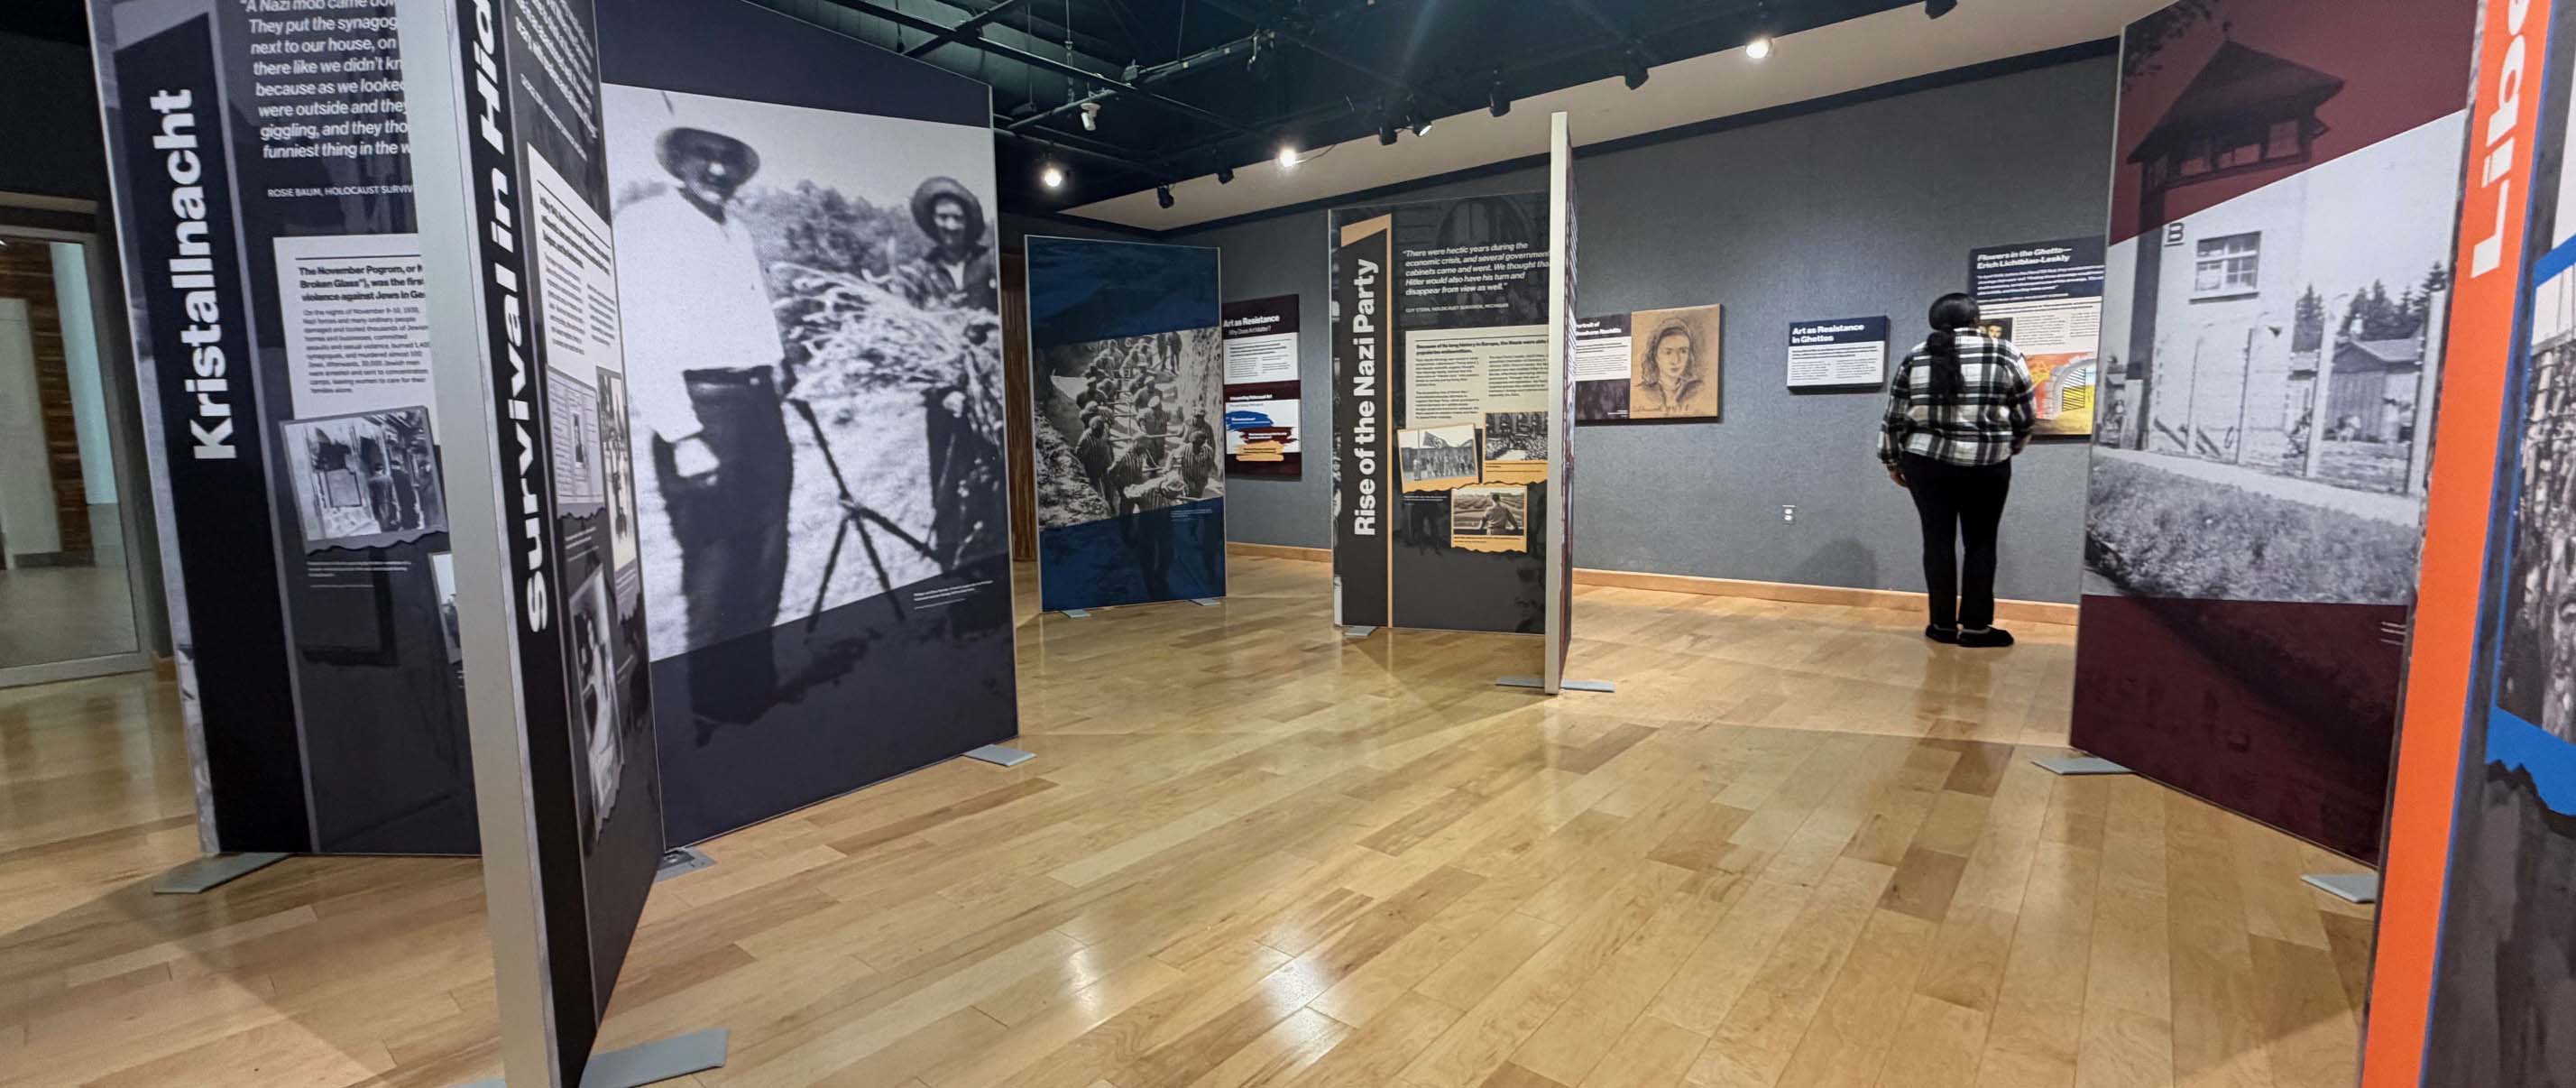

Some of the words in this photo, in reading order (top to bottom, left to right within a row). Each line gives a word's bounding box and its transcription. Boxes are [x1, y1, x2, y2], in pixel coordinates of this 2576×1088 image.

[259, 0, 290, 12] Nazi
[293, 0, 325, 11] mob
[327, 0, 368, 8] came
[249, 17, 287, 35] They
[286, 18, 310, 34] put
[312, 16, 336, 31] the
[251, 41, 281, 54] next
[285, 41, 299, 53] to
[302, 41, 326, 52] our
[327, 37, 375, 52] house,
[377, 38, 396, 49] on
[253, 61, 291, 76] there
[293, 60, 317, 74] like
[320, 61, 341, 72] we
[255, 82, 316, 97] because
[317, 85, 335, 94] as
[337, 83, 358, 94] we
[258, 105, 294, 117] were
[296, 101, 348, 115] outside
[350, 100, 378, 113] and
[260, 124, 319, 141] giggling,
[322, 122, 349, 135] and
[352, 121, 382, 136] they
[262, 144, 319, 159] funniest
[322, 143, 357, 159] thing
[360, 143, 373, 155] in
[375, 141, 398, 154] the
[268, 189, 294, 198] ROSIE
[295, 188, 324, 198] BAUM,
[325, 186, 379, 195] HOLOCAUST
[491, 166, 515, 254] in
[2167, 222, 2185, 243] B
[1491, 244, 1514, 253] during
[1405, 259, 1440, 267] economic
[1478, 254, 1504, 262] several
[1977, 254, 2010, 262] Flowers
[150, 88, 237, 460] Kristallnacht
[299, 267, 316, 276] The
[317, 266, 364, 275] November
[366, 265, 405, 275] Pogrom,
[1405, 269, 1436, 277] cabinets
[1507, 262, 1535, 271] thought
[299, 280, 333, 289] Broken
[391, 278, 405, 287] the
[1426, 276, 1447, 284] would
[1511, 272, 1525, 280] and
[301, 293, 339, 301] violence
[341, 292, 374, 302] against
[376, 291, 400, 300] Jews
[400, 290, 409, 299] in
[1353, 259, 1379, 334] Party
[1405, 287, 1440, 296] disappear
[1223, 319, 1234, 327] Art
[1242, 315, 1280, 325] Resistance
[1817, 324, 1864, 334] Resistance
[1353, 335, 1375, 397] Nazi
[1354, 400, 1375, 446] the
[492, 258, 552, 632] Survival
[1354, 450, 1375, 476] of
[1354, 477, 1375, 537] Rise
